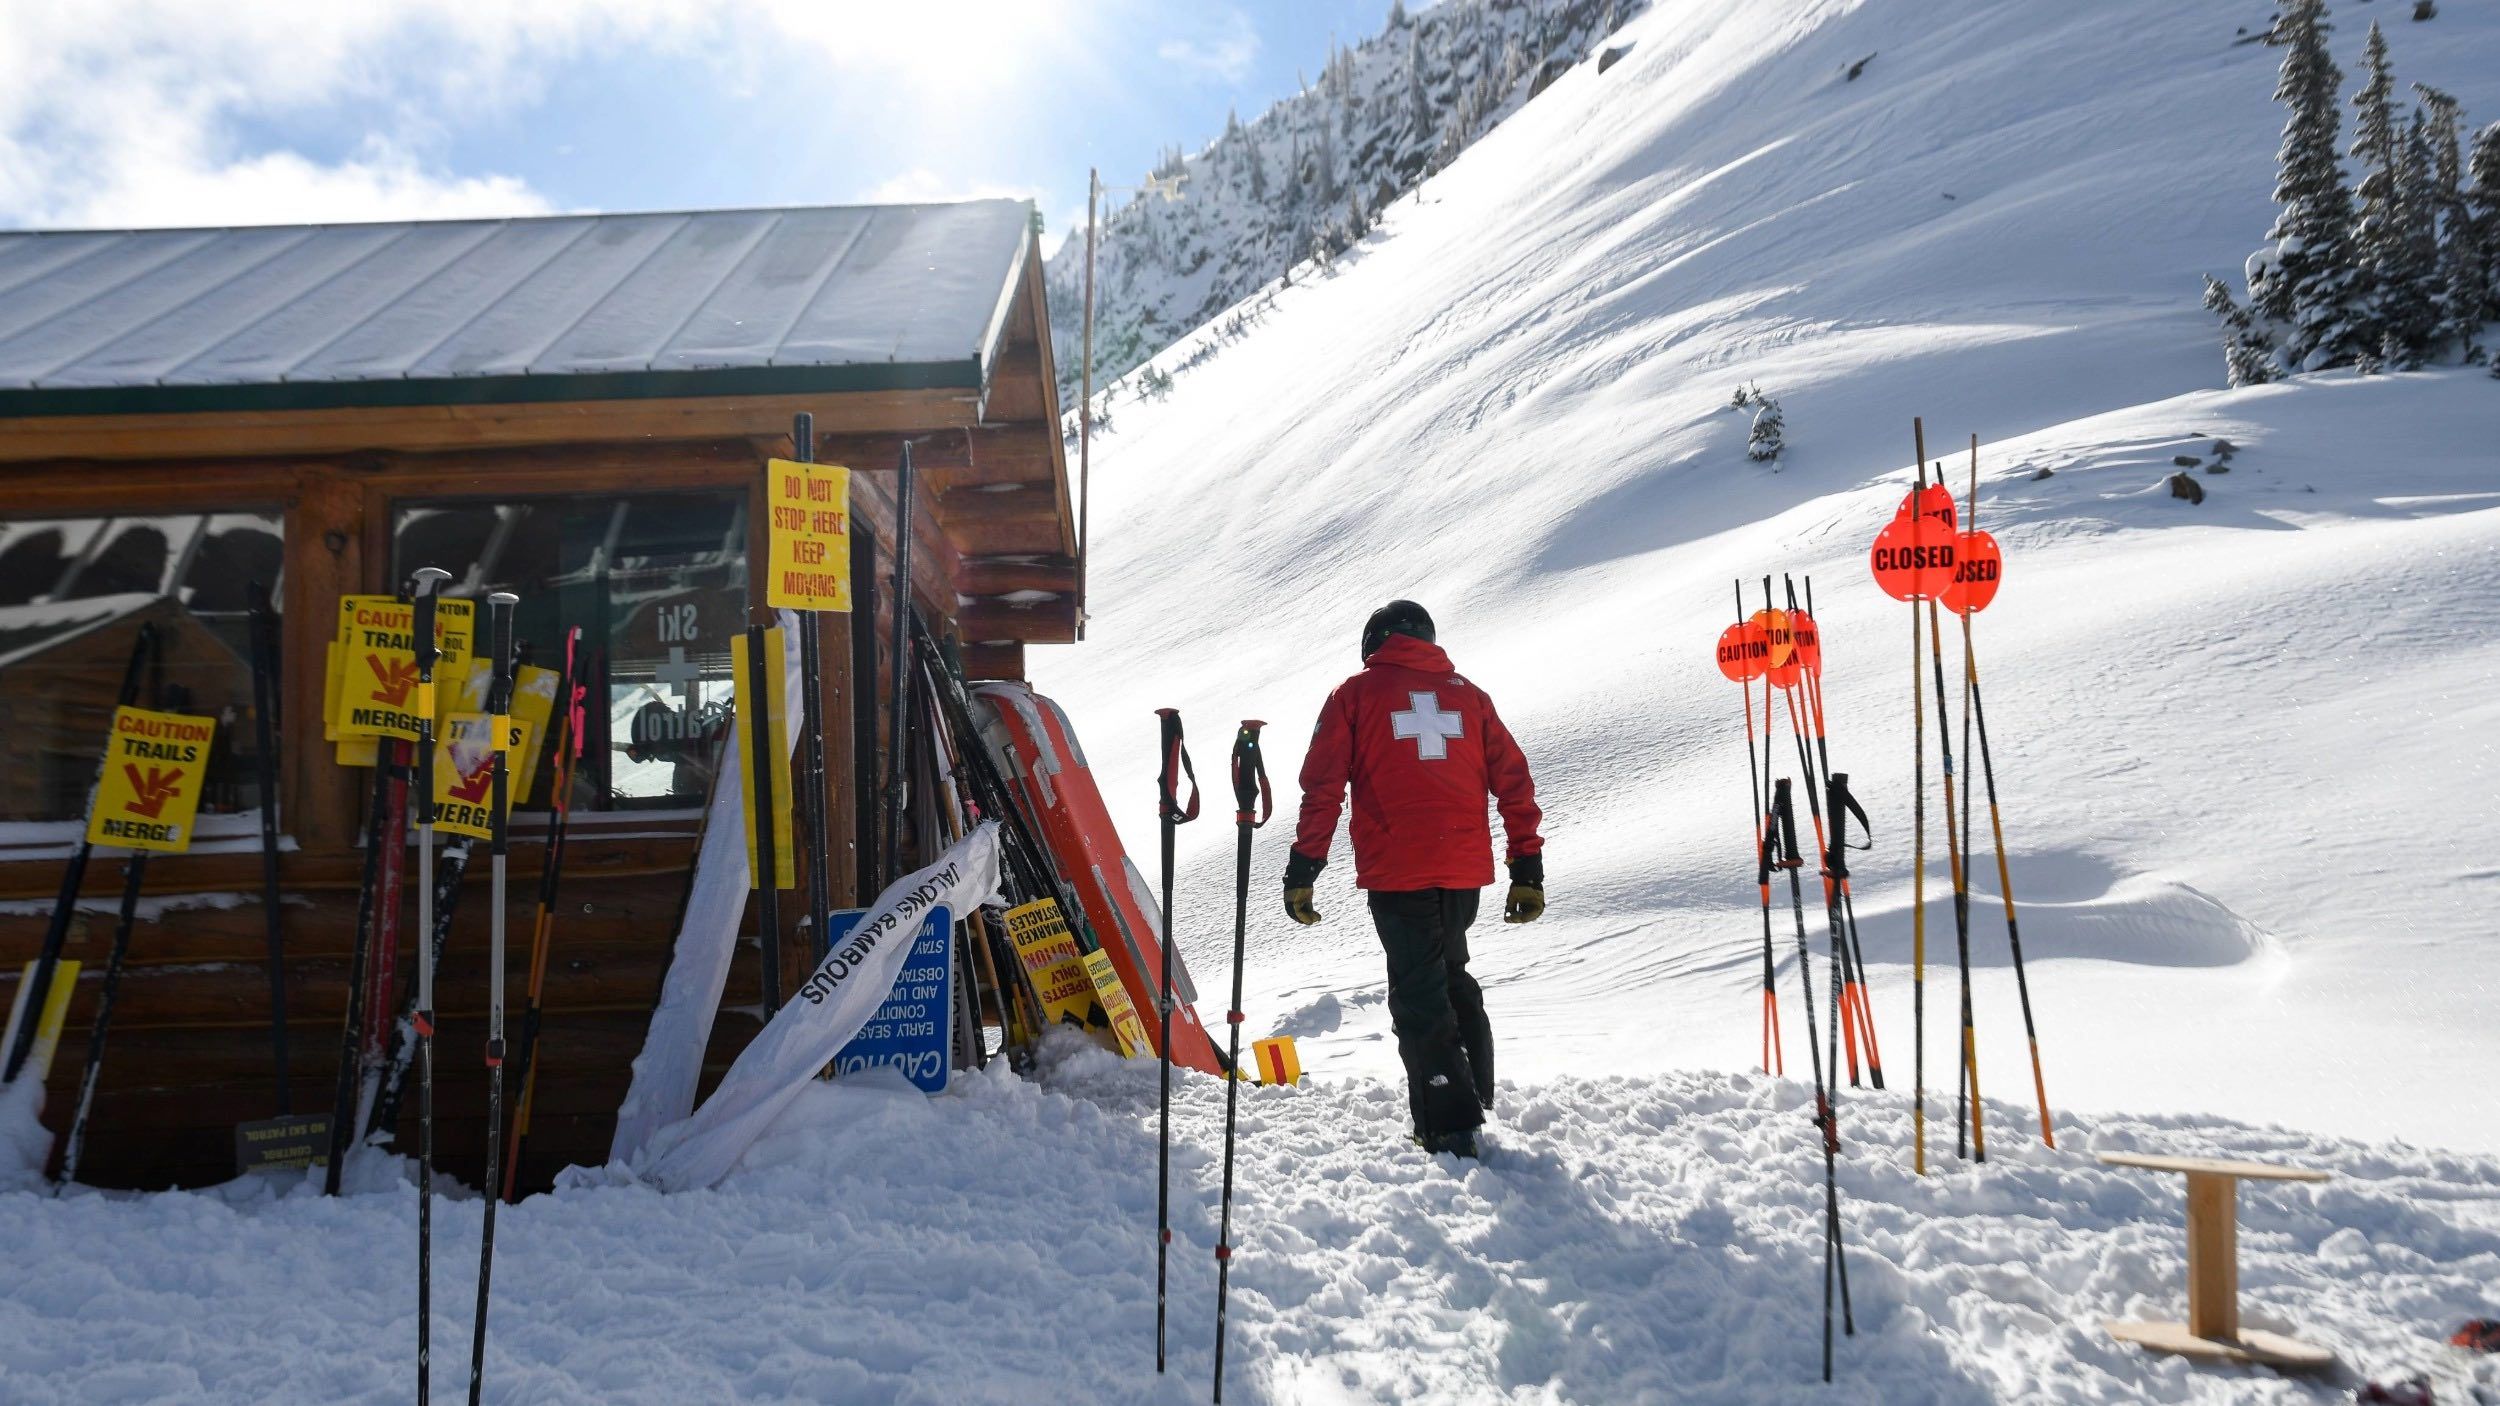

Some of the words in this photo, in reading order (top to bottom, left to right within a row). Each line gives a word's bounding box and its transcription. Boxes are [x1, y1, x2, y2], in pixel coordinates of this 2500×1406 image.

[785, 475, 801, 499] DO
[808, 477, 832, 502] NOT
[775, 506, 806, 531] STOP
[813, 510, 845, 535] HERE
[793, 540, 825, 565] KEEP
[1875, 545, 1954, 571] CLOSED
[1954, 558, 1998, 584] OSED
[784, 571, 836, 597] MOVING
[1719, 640, 1769, 663] CAUTION
[118, 715, 210, 741] CAUTION
[352, 708, 422, 733] MERGE
[123, 738, 198, 762] TRAILS
[895, 861, 961, 921] JALONS
[1009, 904, 1061, 932] BSTACLES
[1016, 919, 1069, 947] NMARKED
[800, 912, 898, 1005] BAMBOUS
[914, 939, 945, 956] STAY
[1023, 940, 1078, 971] AUTION
[896, 967, 945, 983] OBSTAC
[1051, 965, 1082, 985] ONLY
[911, 985, 938, 999] AND
[867, 1004, 926, 1020] CONDITI
[854, 1023, 892, 1040] SEAS
[896, 1021, 934, 1038] EARLY
